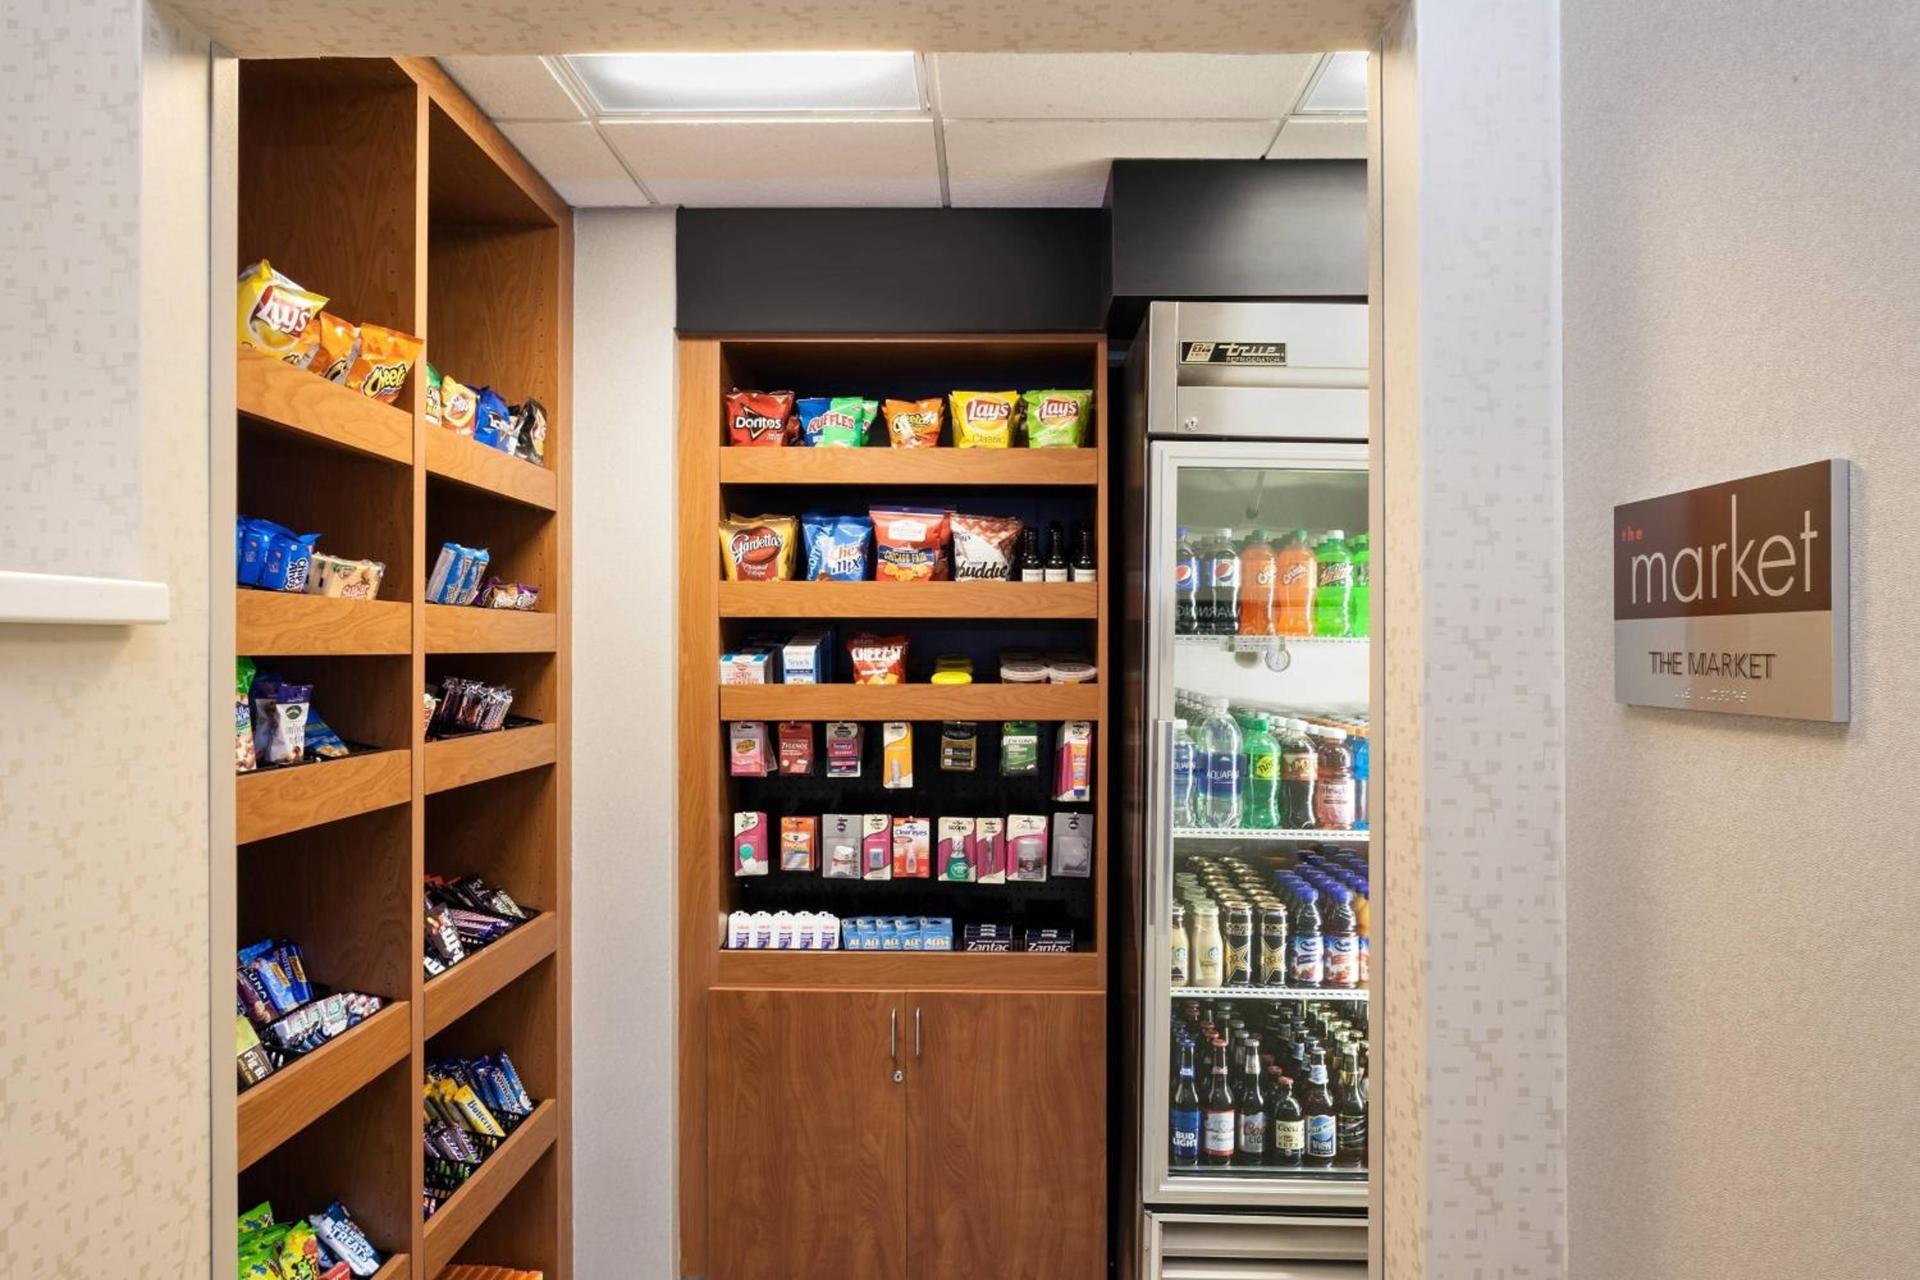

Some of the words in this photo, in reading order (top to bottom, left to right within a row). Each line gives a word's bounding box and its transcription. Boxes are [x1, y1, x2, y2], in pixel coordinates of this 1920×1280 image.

[735, 416, 782, 429] Doritos
[807, 411, 855, 434] RUFFLES
[1621, 526, 1643, 542] the
[1632, 494, 1818, 604] market
[1648, 651, 1683, 675] THE
[1688, 652, 1777, 679] MARKET
[967, 941, 1010, 952] Zantac
[1027, 942, 1071, 953] Zantac
[1172, 1137, 1198, 1148] LIGHT
[1175, 1131, 1195, 1140] BUD
[329, 1225, 370, 1263] TREATS
